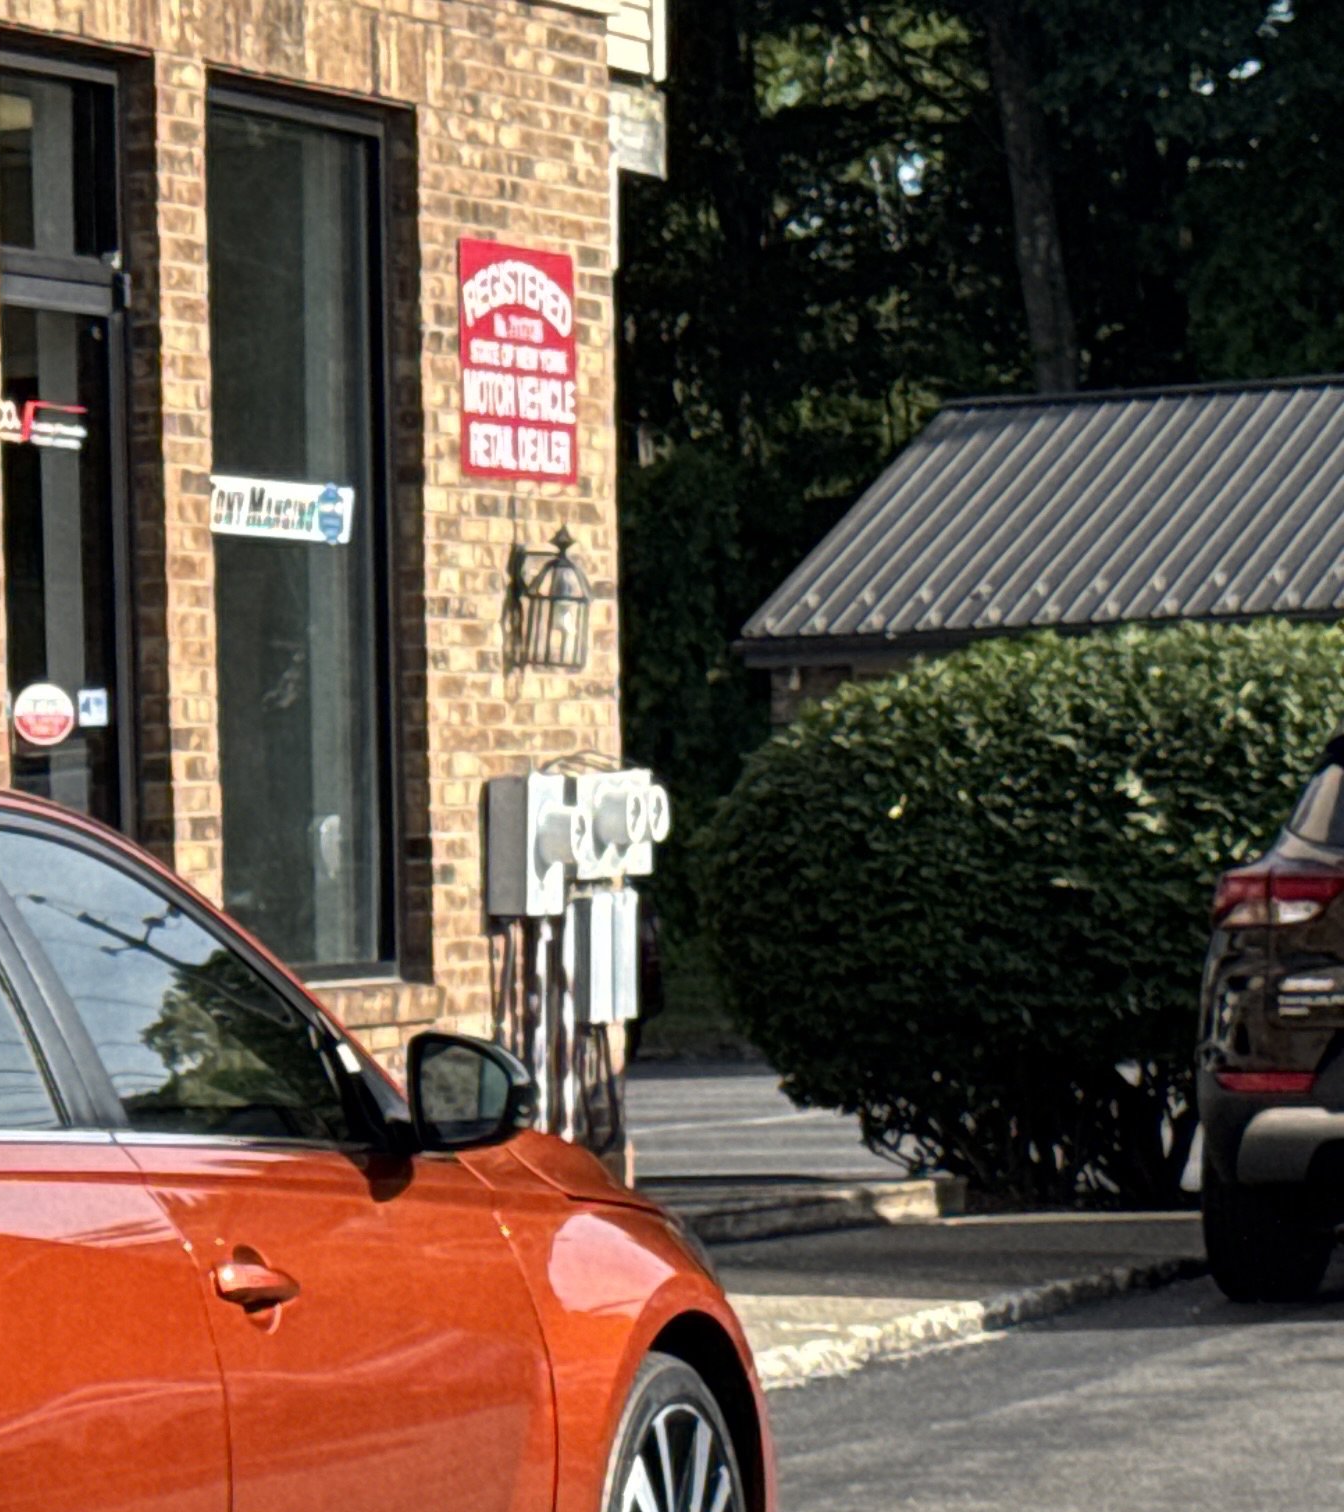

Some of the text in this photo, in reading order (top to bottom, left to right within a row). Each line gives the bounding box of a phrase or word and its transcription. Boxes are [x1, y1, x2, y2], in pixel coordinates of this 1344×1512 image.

[463, 259, 572, 337] REGISTERED
[463, 367, 576, 425] MOTOR VEHICLE
[469, 420, 571, 475] RETAIL DEALER
